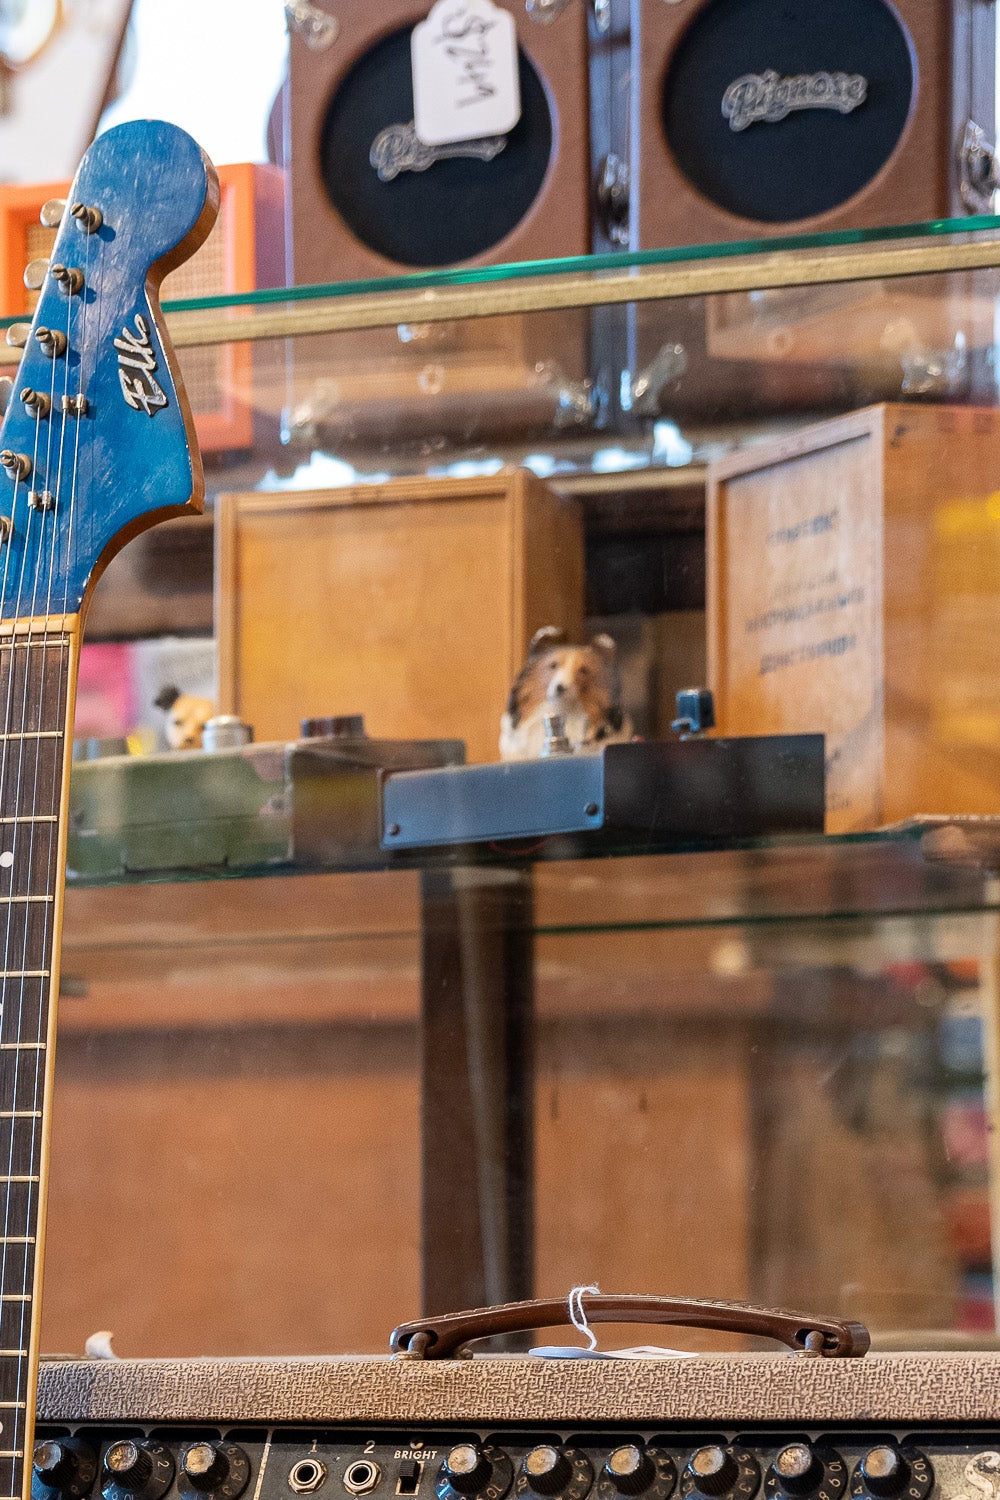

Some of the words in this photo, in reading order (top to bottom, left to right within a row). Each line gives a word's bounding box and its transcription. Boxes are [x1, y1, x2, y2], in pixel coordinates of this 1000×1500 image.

[113, 313, 168, 418] Elk
[363, 1440, 376, 1454] 2
[393, 1450, 438, 1460] BRIGHT
